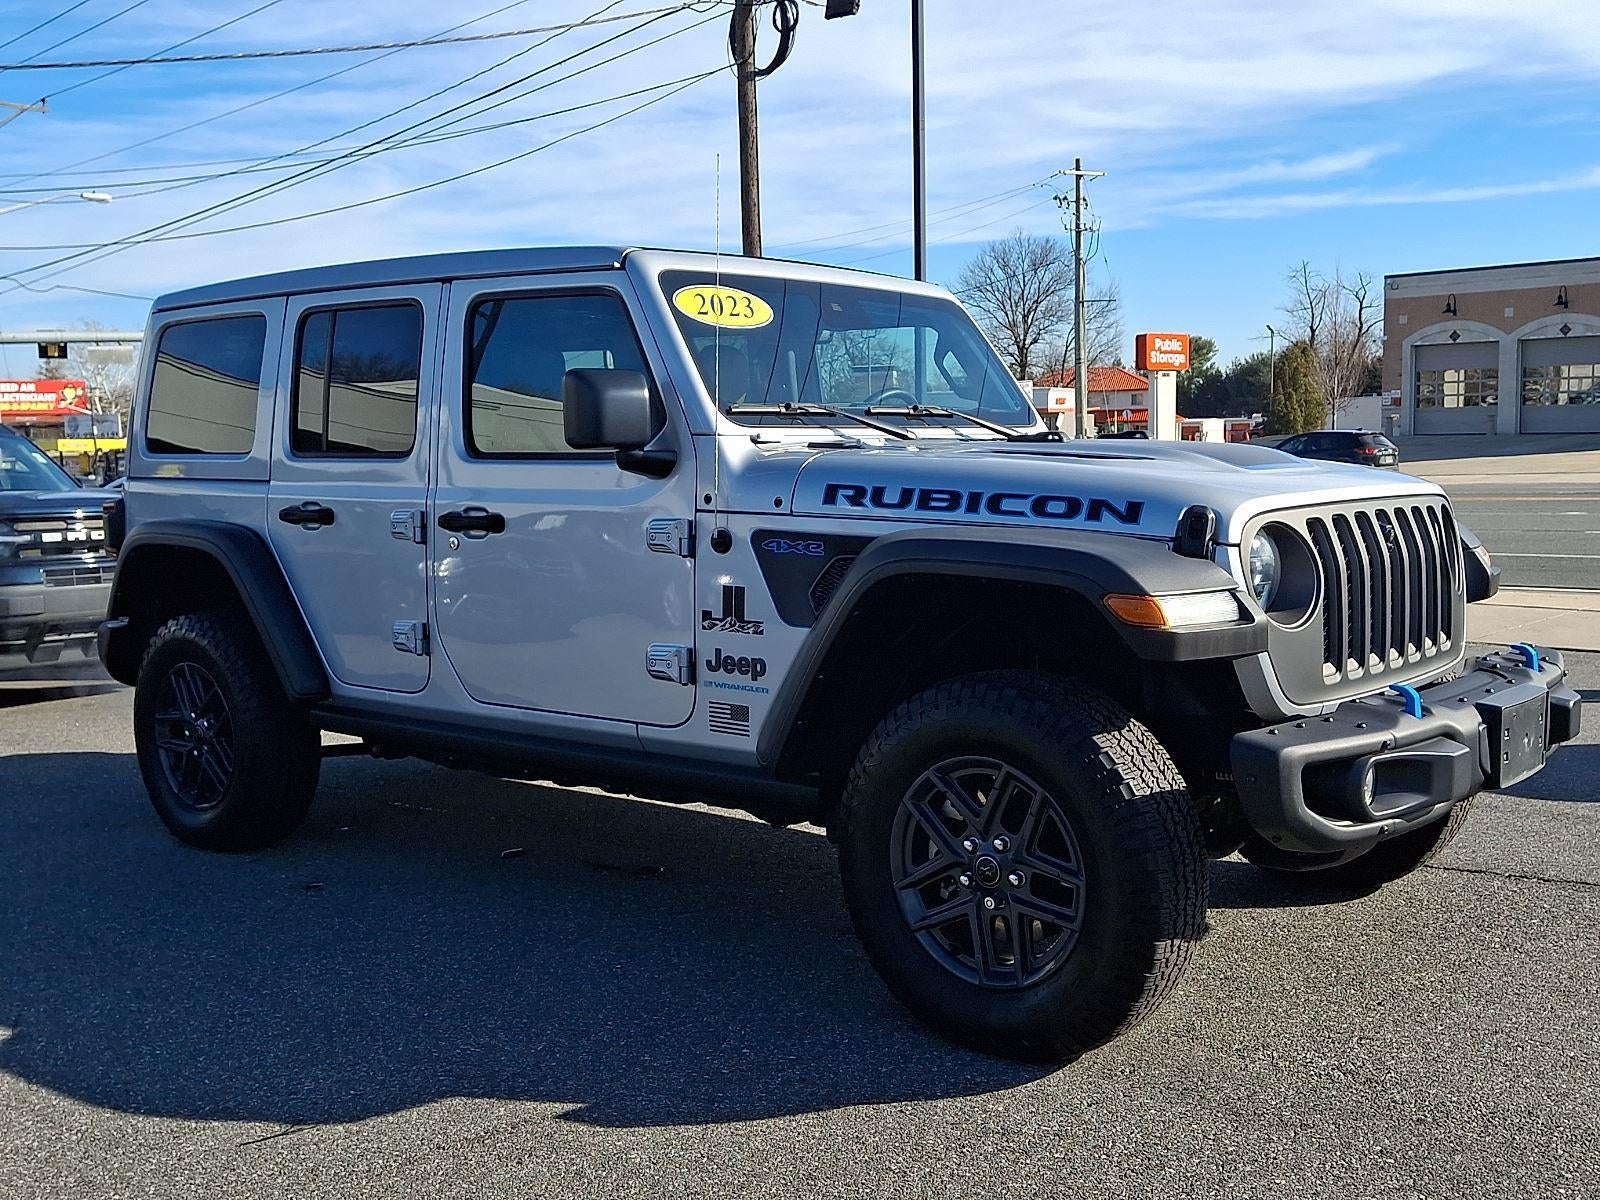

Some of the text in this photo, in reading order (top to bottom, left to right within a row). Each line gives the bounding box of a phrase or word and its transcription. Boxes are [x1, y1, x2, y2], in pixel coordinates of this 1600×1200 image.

[693, 293, 755, 319] 2023
[1154, 338, 1183, 351] Public
[1150, 351, 1187, 367] Storage
[821, 482, 1145, 526] RUBICON
[701, 585, 765, 636] JL
[705, 647, 768, 682] Jeep
[711, 681, 769, 695] WRANGLER
